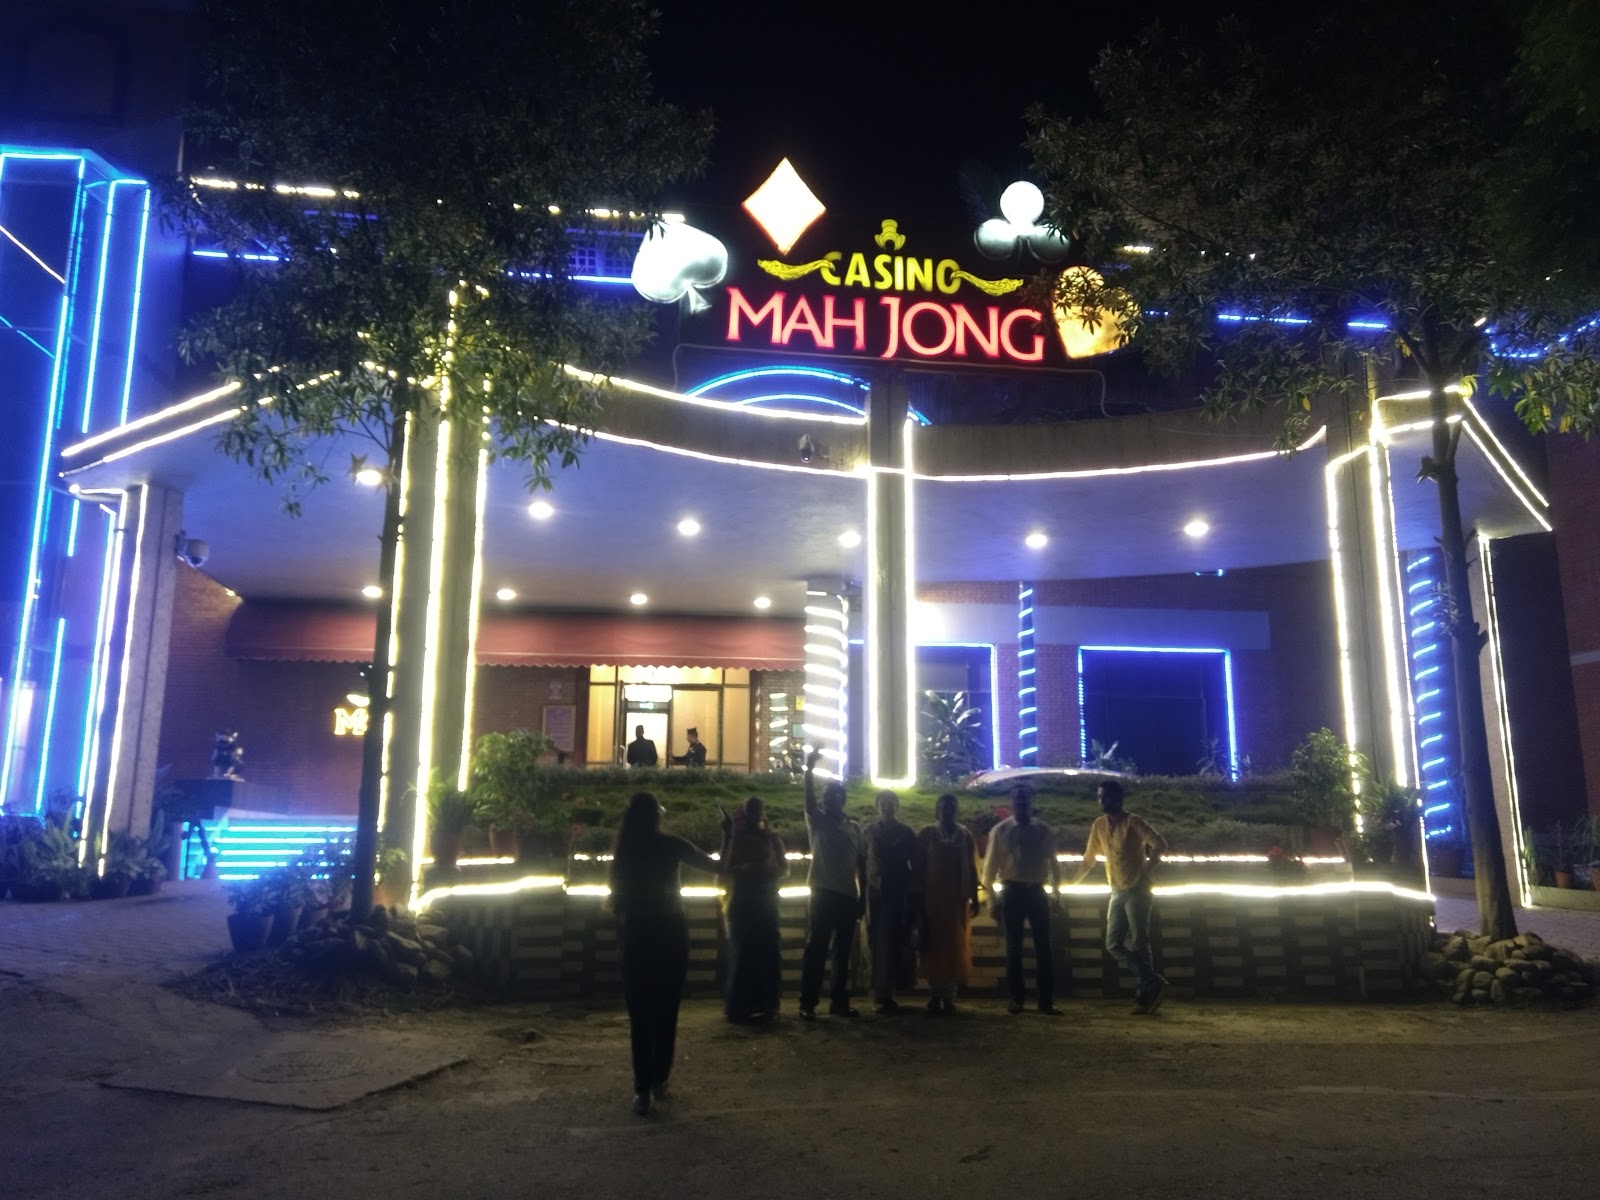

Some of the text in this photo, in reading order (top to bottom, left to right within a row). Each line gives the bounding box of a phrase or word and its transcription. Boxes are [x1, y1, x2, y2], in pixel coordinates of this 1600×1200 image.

[821, 251, 961, 294] CASINO
[726, 287, 1046, 361] MAH JONG
